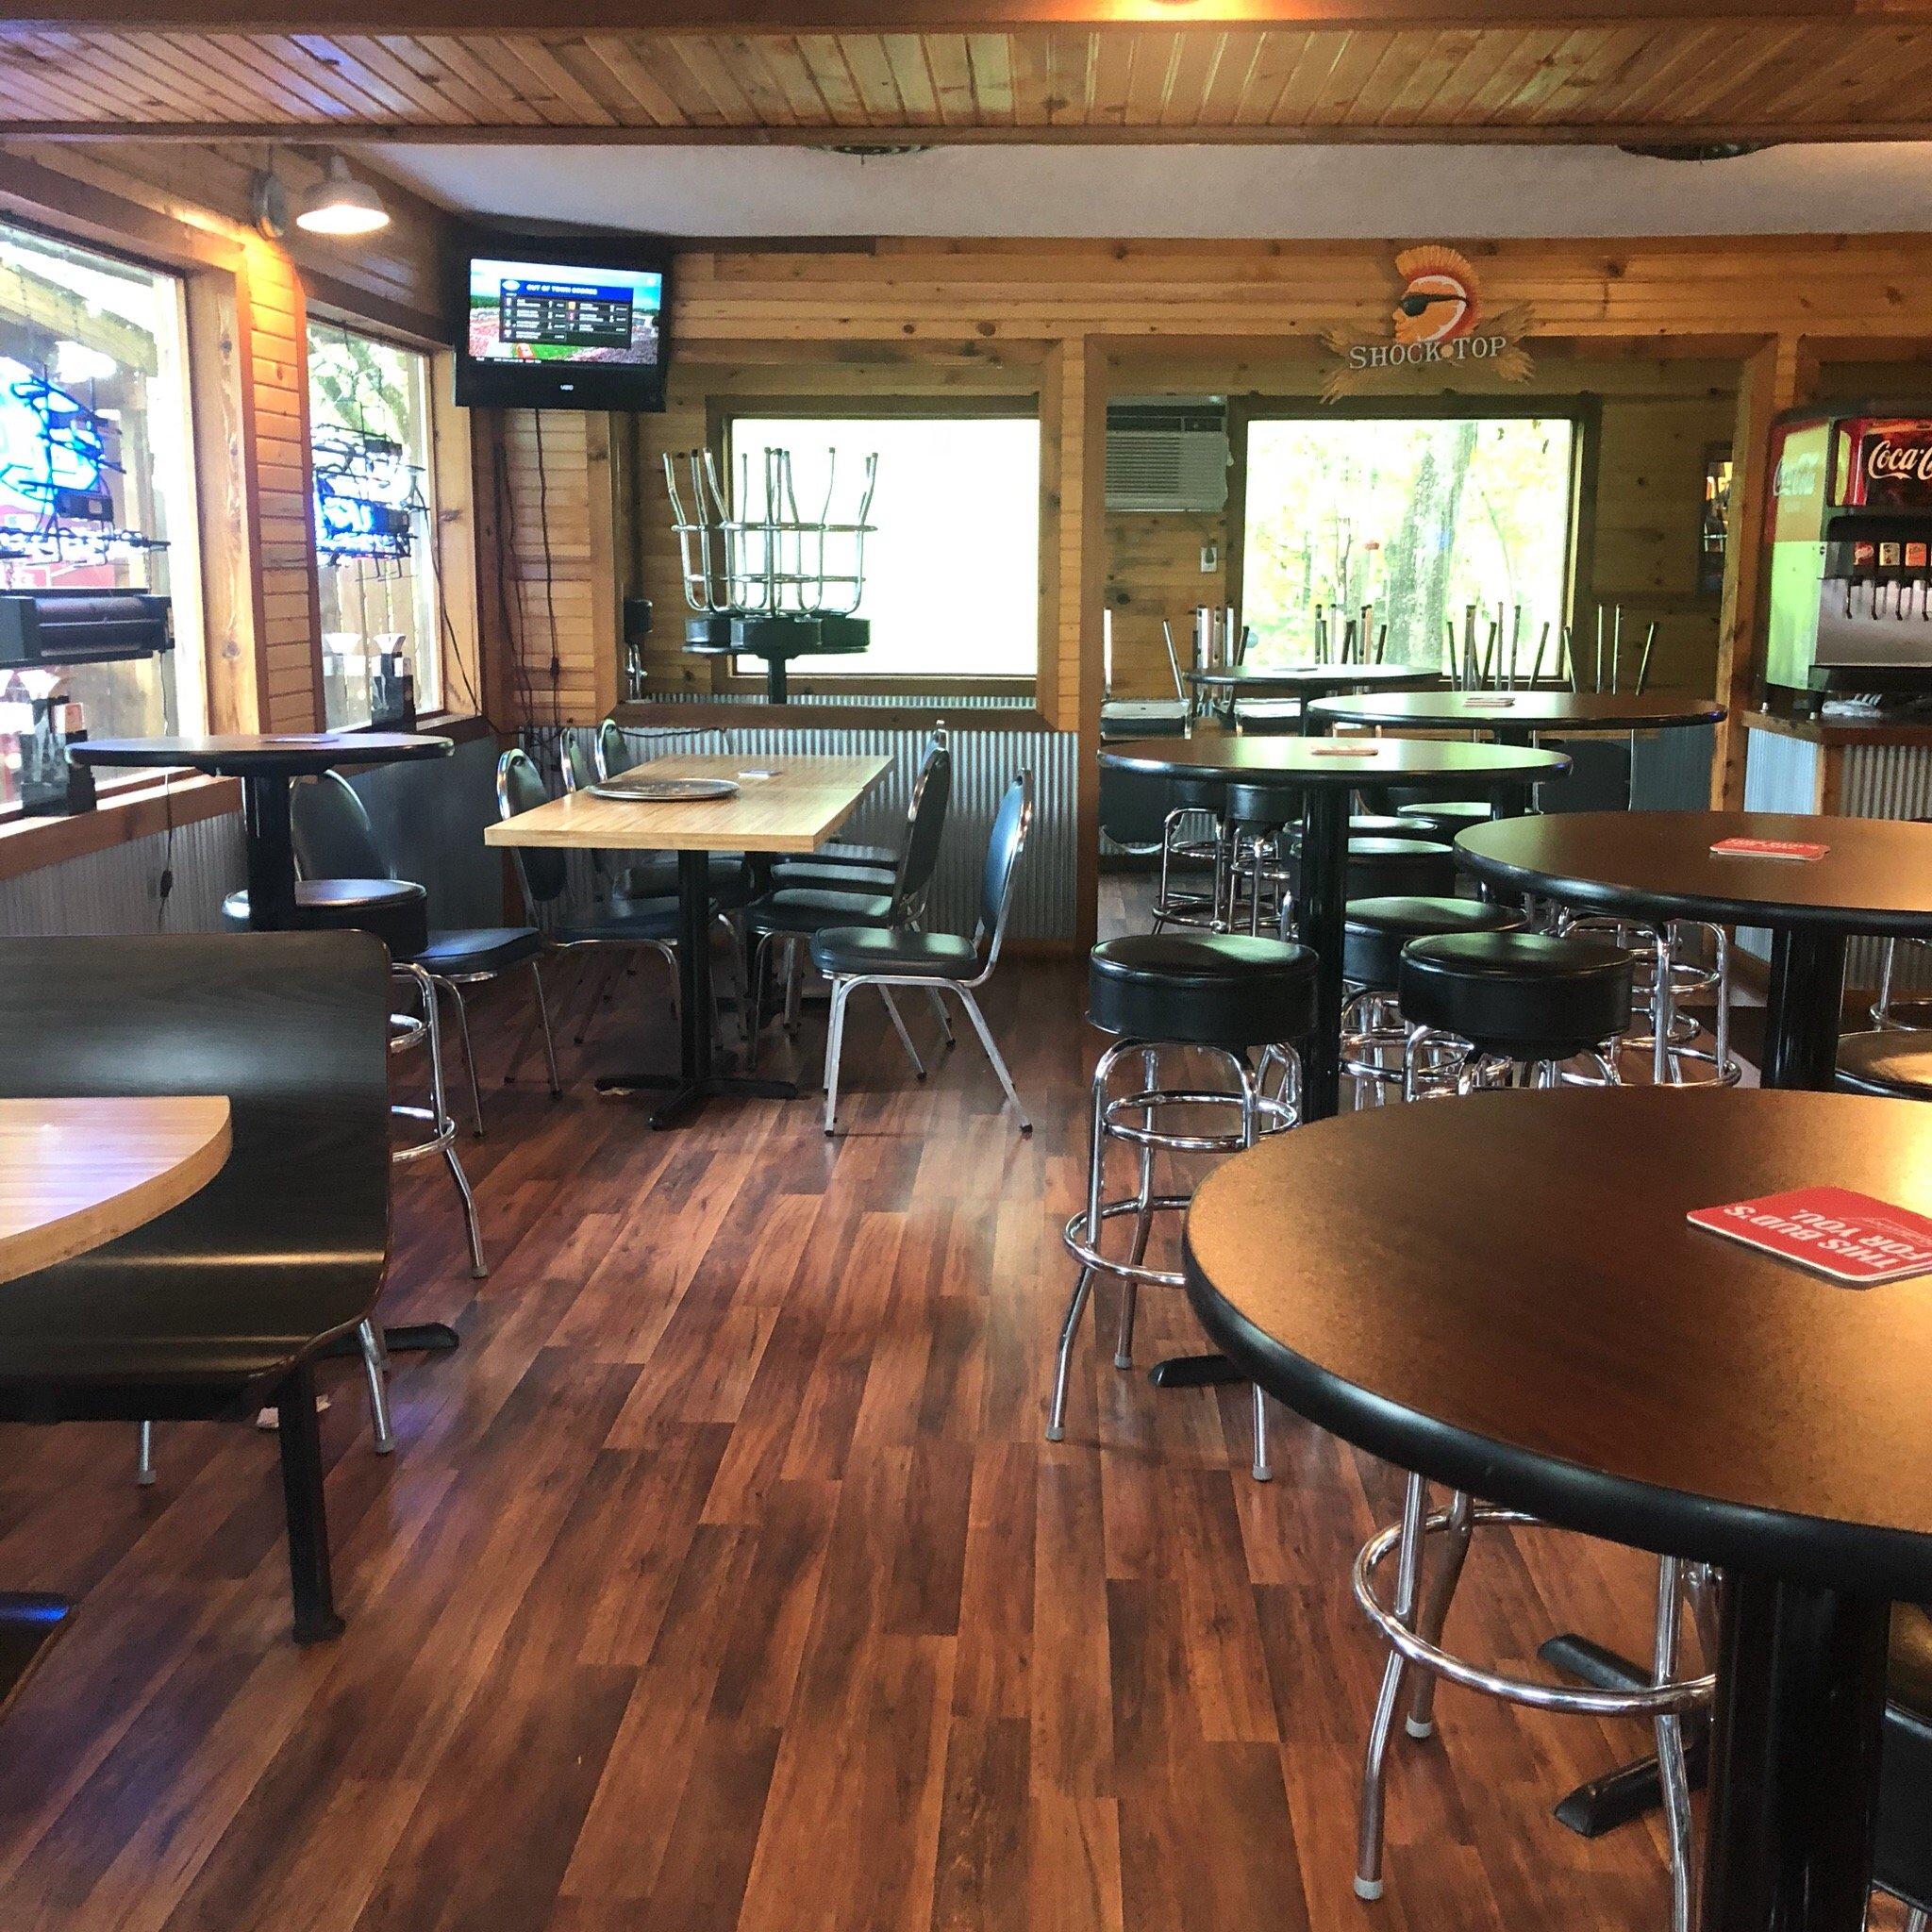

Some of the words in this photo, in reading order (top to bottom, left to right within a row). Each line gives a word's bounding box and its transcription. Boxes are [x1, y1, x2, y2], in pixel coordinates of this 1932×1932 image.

[1349, 341, 1442, 369] SHOCK
[1453, 336, 1507, 359] TOP
[1724, 1206, 1825, 1241] BUD'S
[1817, 1239, 1900, 1269] THIS
[1858, 1235, 1932, 1260] FOR
